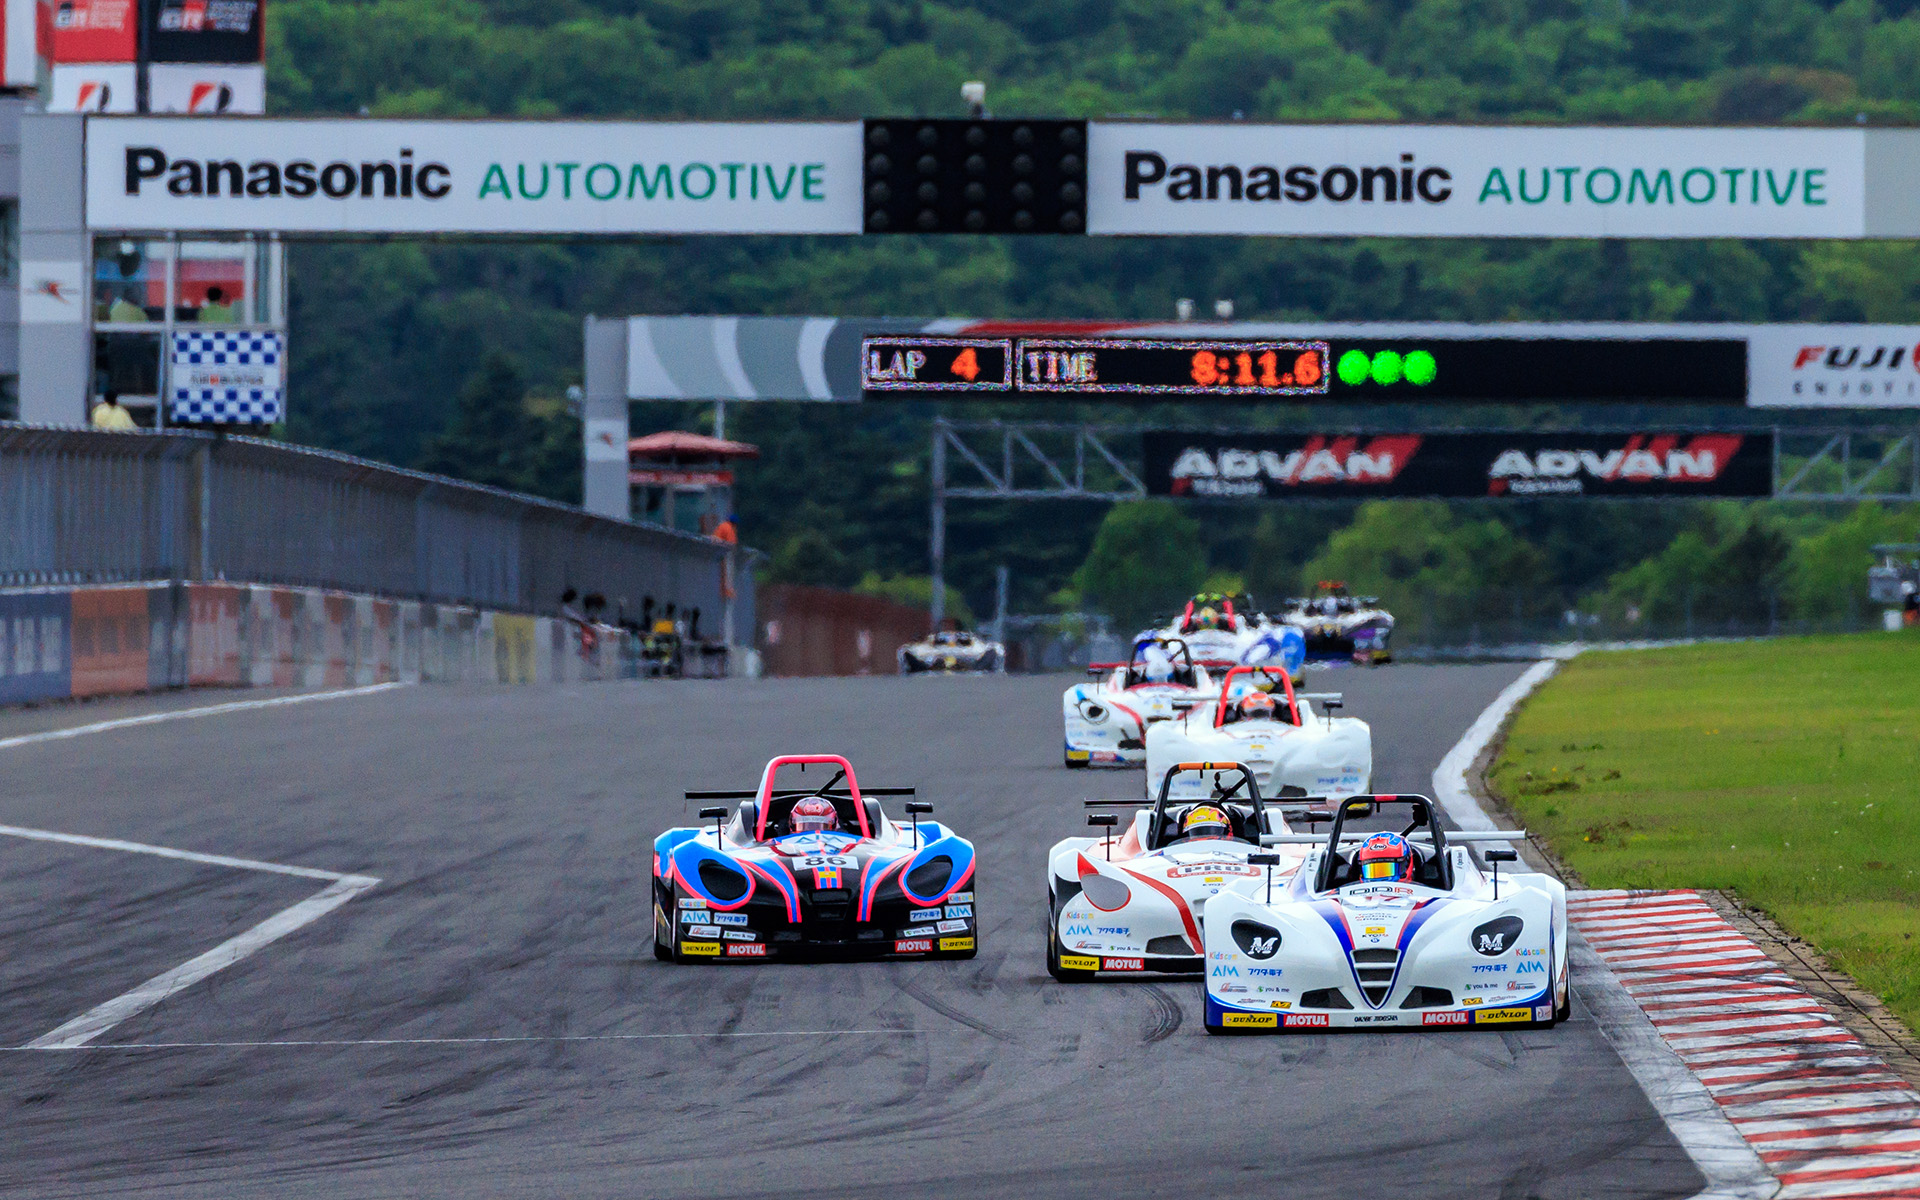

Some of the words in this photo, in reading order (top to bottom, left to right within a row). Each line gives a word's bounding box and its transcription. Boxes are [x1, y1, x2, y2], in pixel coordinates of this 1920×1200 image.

[125, 147, 452, 199] Panasonic
[479, 163, 825, 200] AUTOMOTIVE
[1124, 150, 1453, 202] Panasonic
[1478, 167, 1827, 205] AUTOMOTIVE
[1794, 345, 1906, 370] FUJI
[870, 350, 927, 379] LAP
[951, 348, 980, 381] 4
[1026, 350, 1098, 382] TIME
[1190, 350, 1321, 386] 8:11.6
[1171, 448, 1394, 480] ADVAN
[1488, 449, 1717, 479] ADVAN
[805, 856, 847, 866] 86
[1066, 924, 1092, 936] AIM
[728, 945, 764, 955] MOTUL
[896, 941, 931, 951] MOTUL
[1064, 959, 1096, 967] DUNLOP
[1105, 959, 1142, 969] MOTUL
[1515, 960, 1545, 974] AIM
[1211, 965, 1239, 977] AIM
[1232, 1015, 1273, 1023] DUNLOP
[1285, 1015, 1328, 1026] MOTUL
[1424, 1011, 1467, 1024] MOTUL
[1487, 1011, 1528, 1019] DUNLOP
